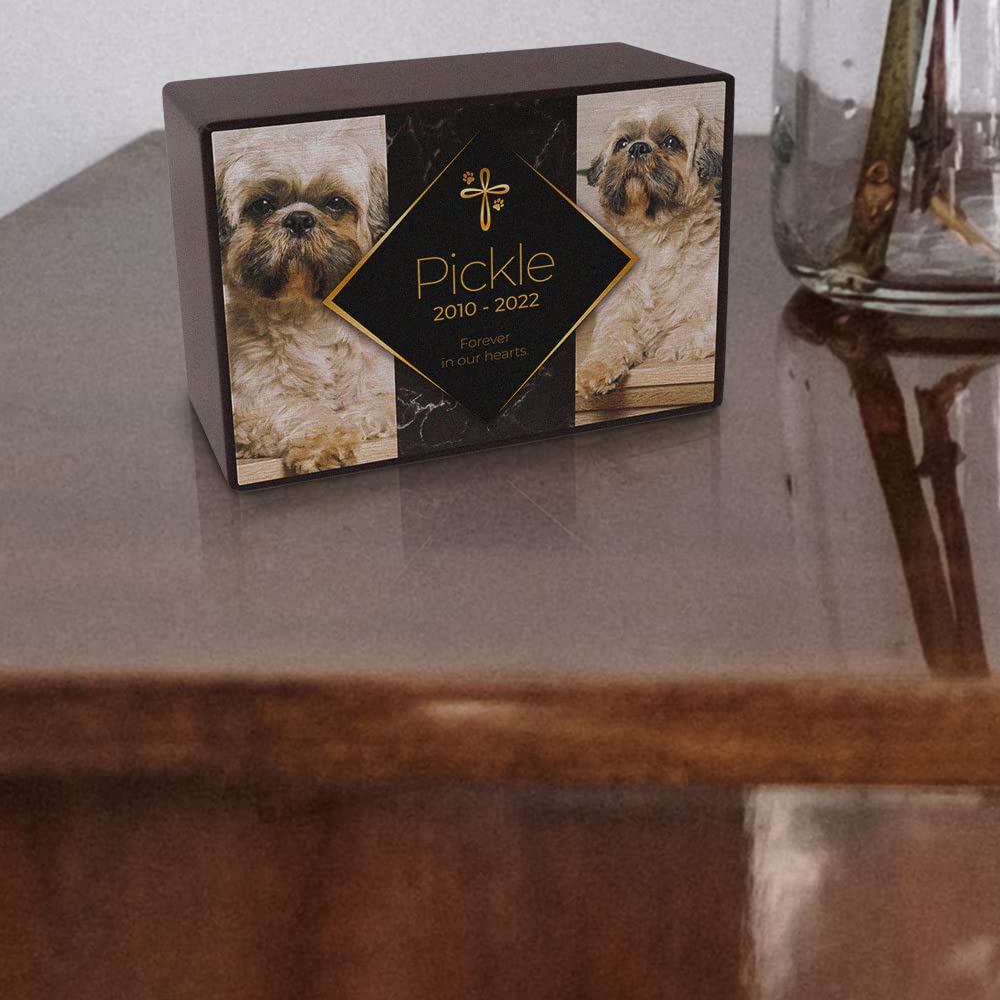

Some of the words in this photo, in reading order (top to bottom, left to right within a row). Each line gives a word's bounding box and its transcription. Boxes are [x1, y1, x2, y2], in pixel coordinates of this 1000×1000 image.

[417, 242, 555, 300] Pickle
[433, 302, 477, 321] 2010
[494, 292, 540, 313] 2022
[460, 333, 510, 349] Forever
[441, 357, 454, 369] in
[457, 353, 480, 366] our
[484, 346, 527, 362] hearts
